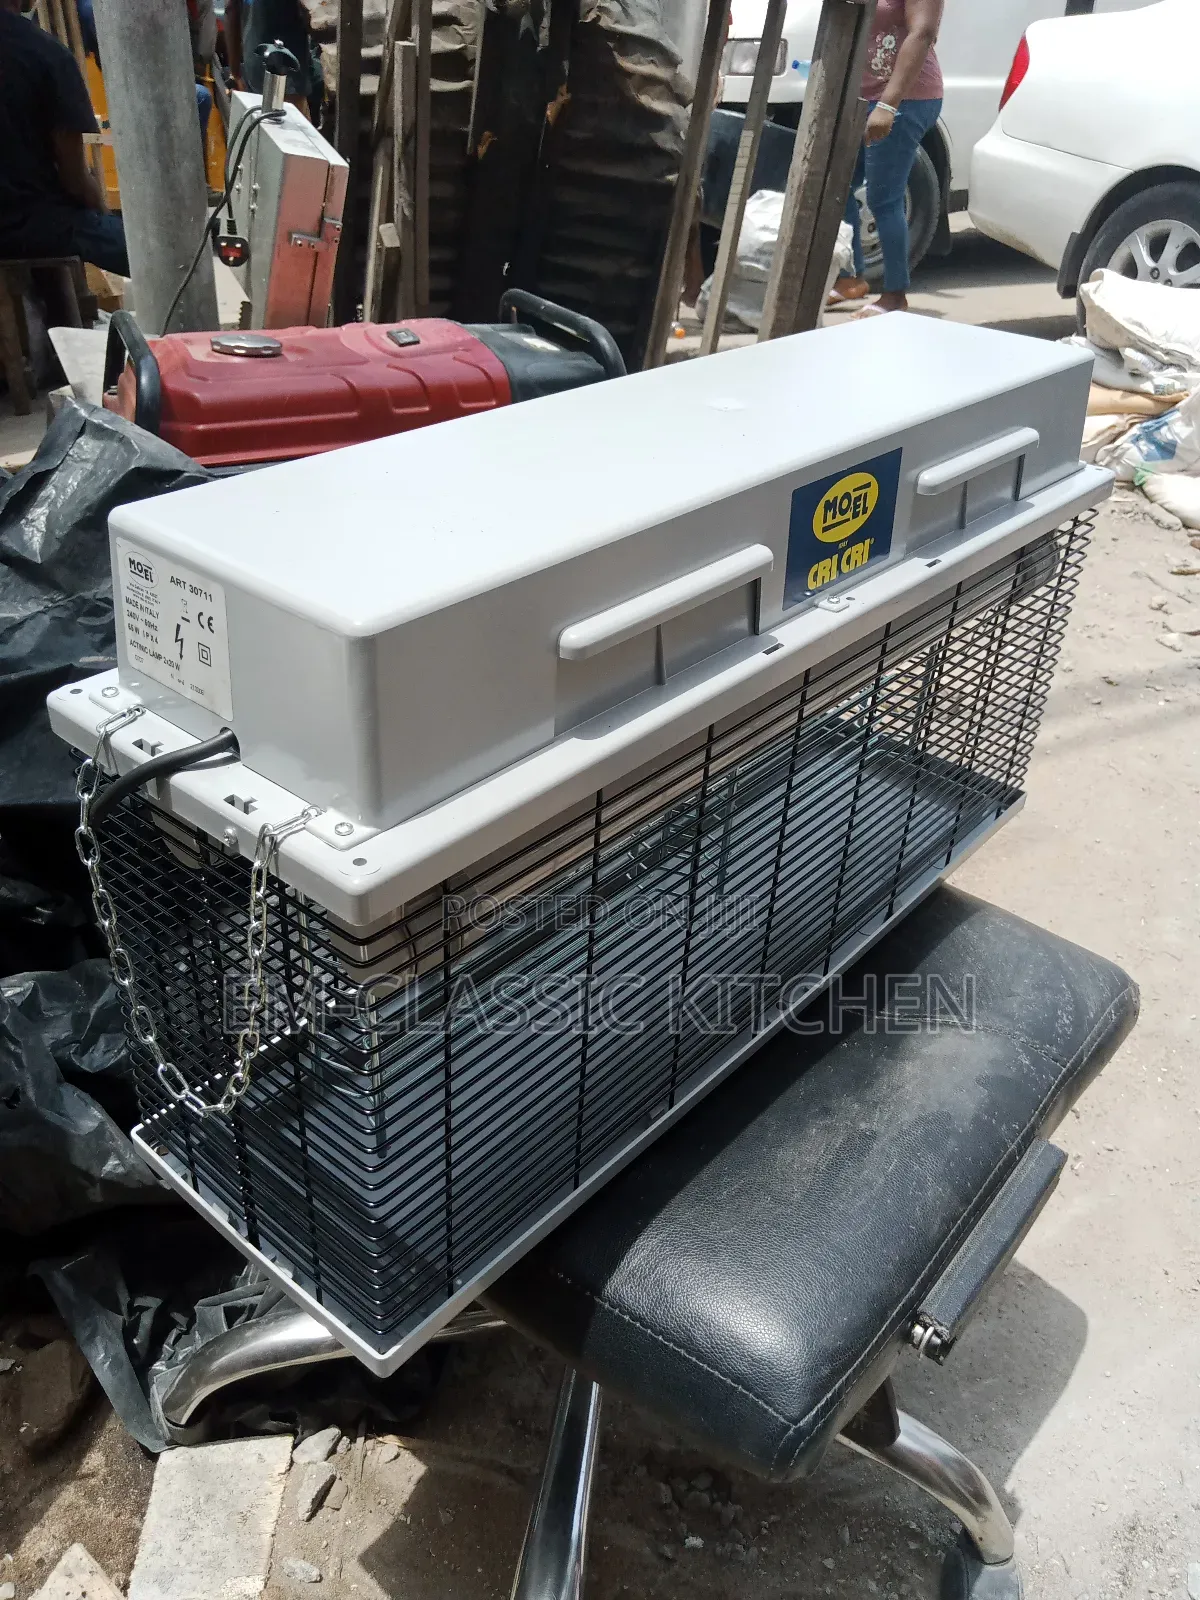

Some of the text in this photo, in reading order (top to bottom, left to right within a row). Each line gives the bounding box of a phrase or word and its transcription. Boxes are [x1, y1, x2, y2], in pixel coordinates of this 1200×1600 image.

[822, 490, 869, 525] MOEL
[128, 557, 154, 584] MOEL
[807, 554, 839, 590] CRI
[169, 575, 213, 603] ART 30711
[125, 595, 160, 620] MADE IN ITALY
[129, 638, 148, 654] ACTINIC
[148, 648, 163, 661] LAMP
